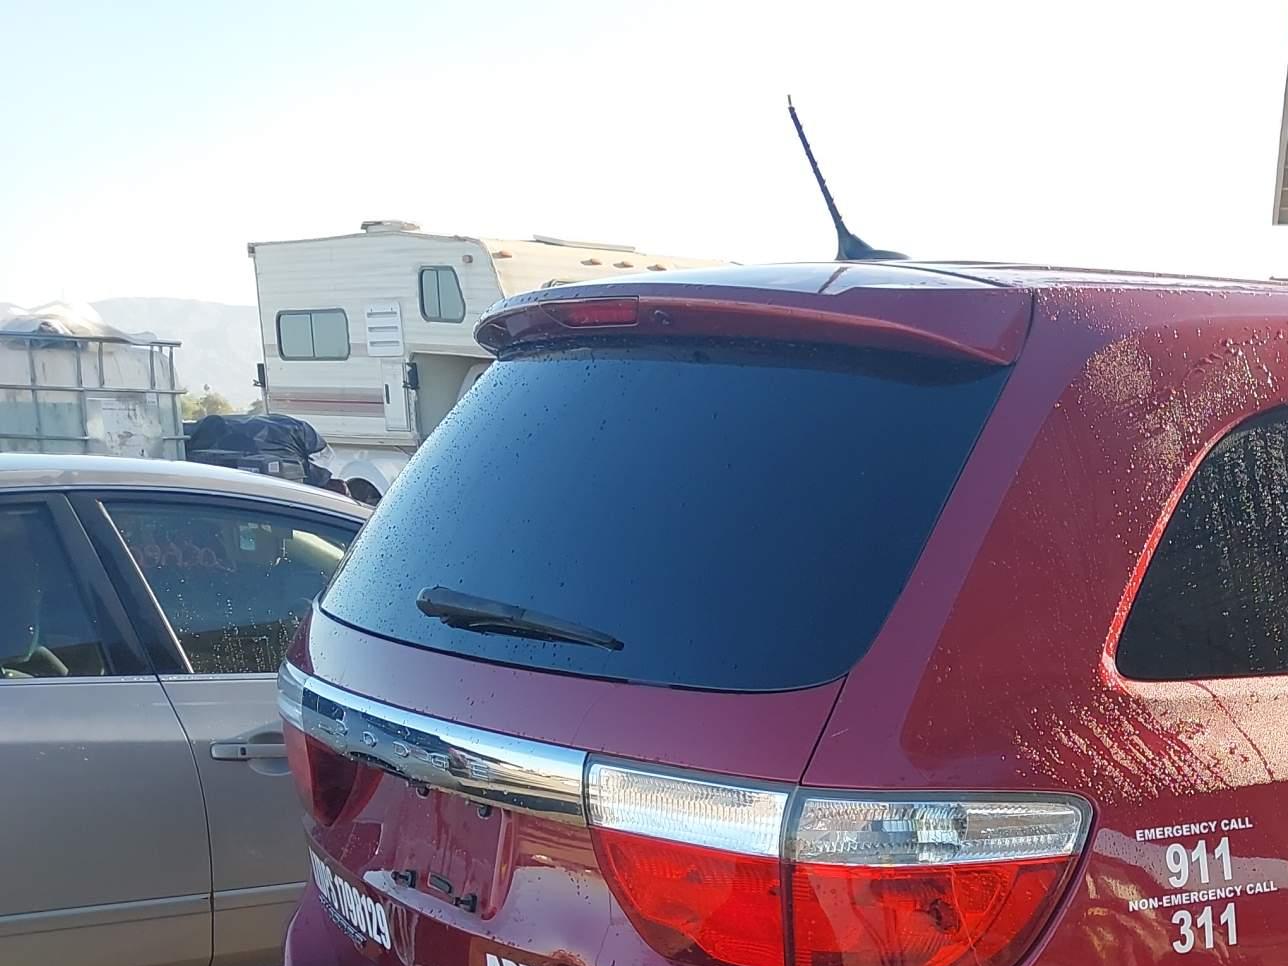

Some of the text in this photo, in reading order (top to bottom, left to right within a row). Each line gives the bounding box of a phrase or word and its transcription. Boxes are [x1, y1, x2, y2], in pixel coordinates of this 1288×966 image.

[1135, 816, 1254, 842] EMERGENCY CALL
[1165, 836, 1233, 888] 911
[1128, 880, 1279, 912] NON-EMERGENCY CALL
[1171, 902, 1238, 955] 311
